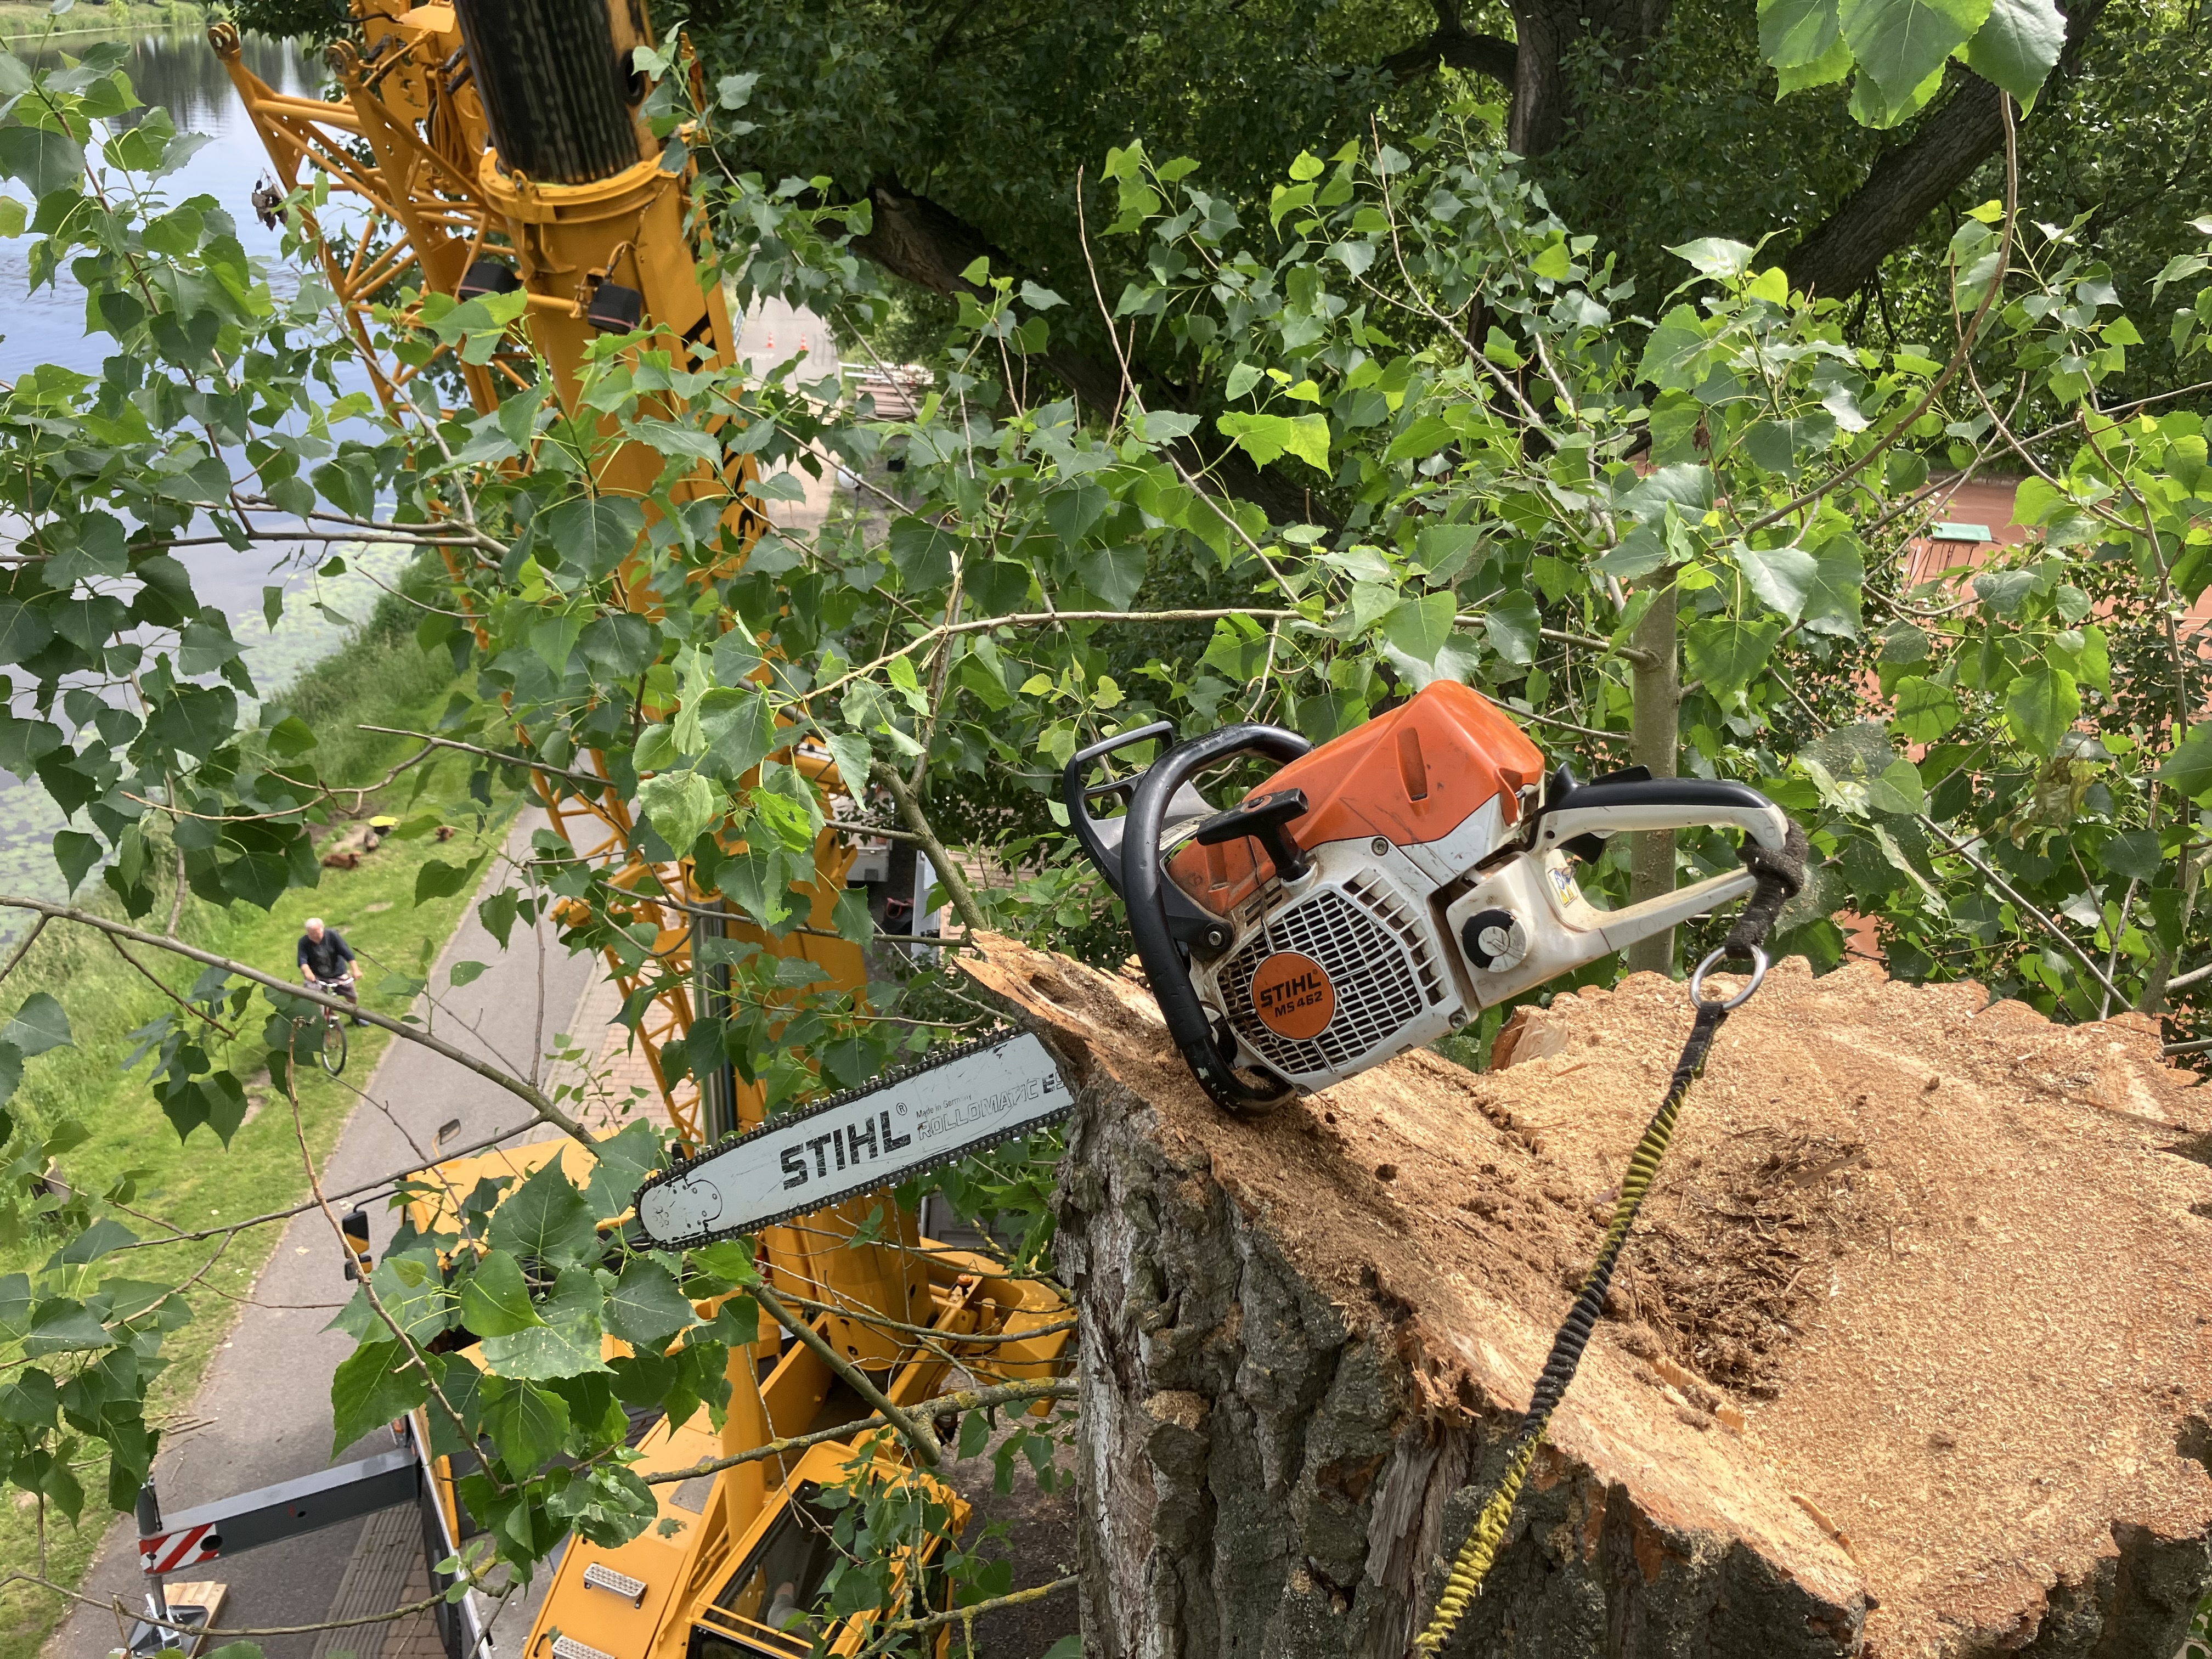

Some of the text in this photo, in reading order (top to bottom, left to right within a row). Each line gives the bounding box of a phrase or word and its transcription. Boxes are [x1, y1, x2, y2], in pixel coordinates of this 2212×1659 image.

[1260, 973, 1321, 1008] STIHL
[1274, 991, 1323, 1018] MS 462
[916, 1094, 972, 1119] Made in Germny
[917, 1079, 1039, 1141] ROLLOMATIC
[780, 1110, 911, 1190] STIHL
